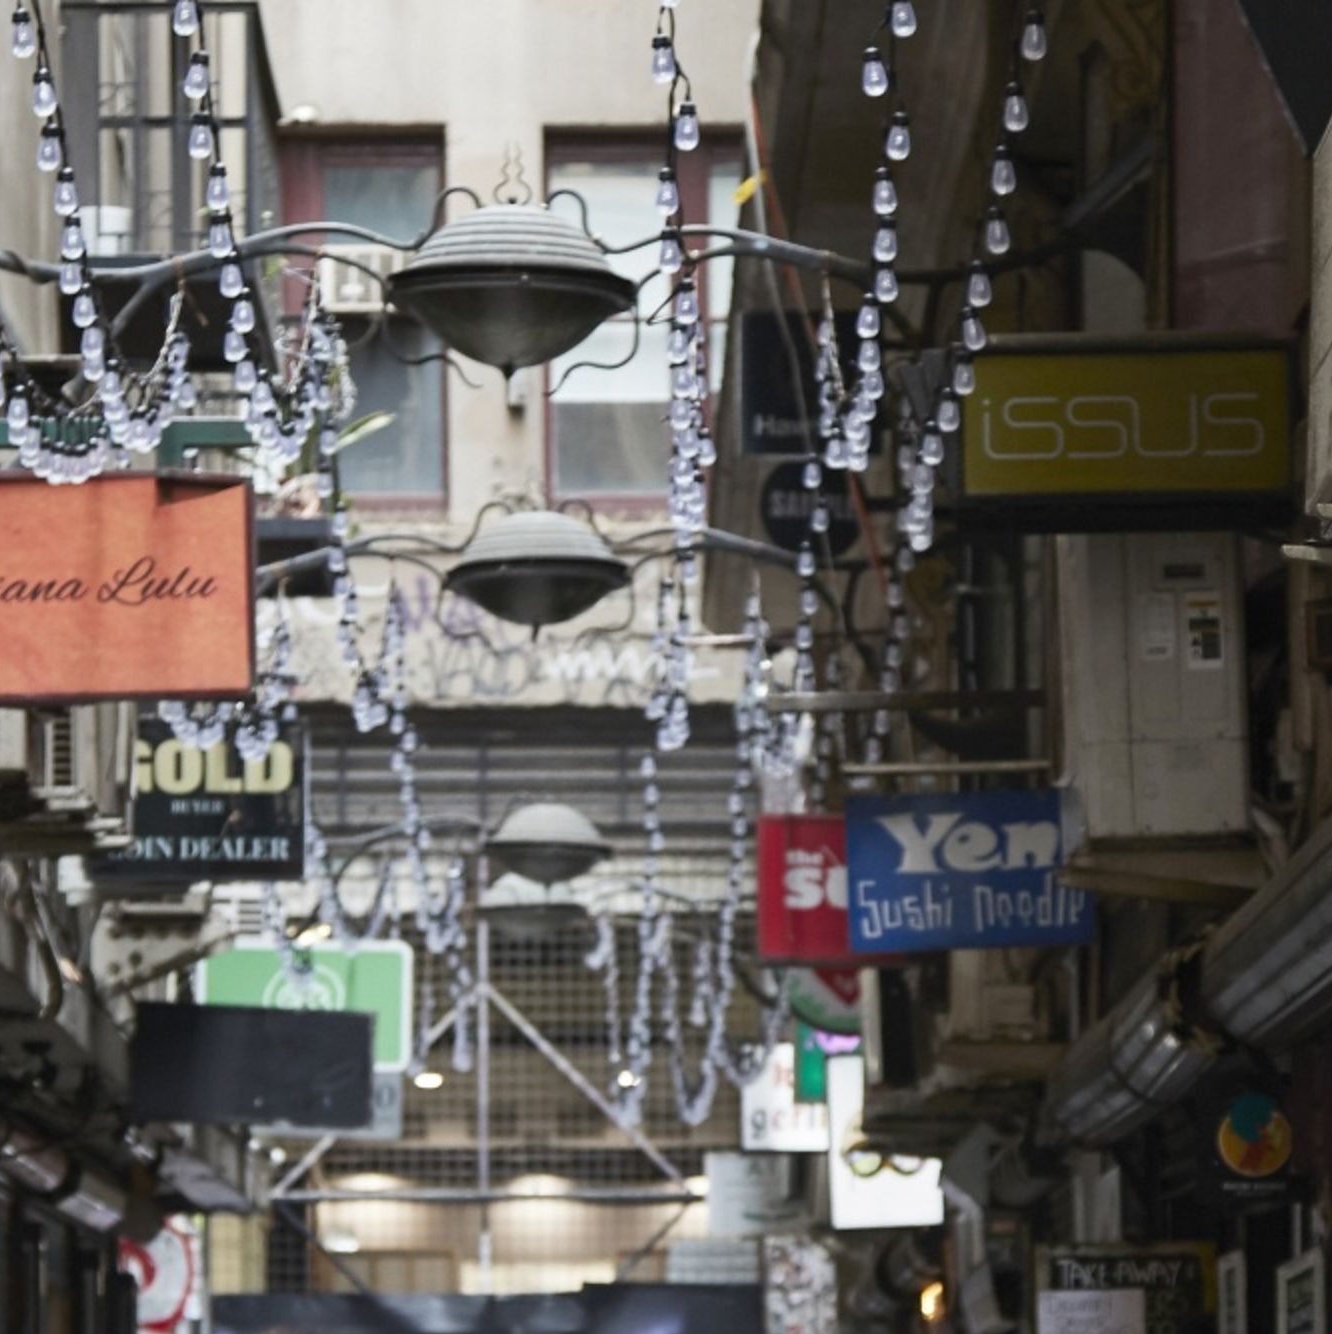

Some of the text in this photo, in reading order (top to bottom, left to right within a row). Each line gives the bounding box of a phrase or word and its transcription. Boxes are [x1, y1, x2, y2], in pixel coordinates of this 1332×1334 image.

[95, 556, 220, 606] Lulu
[125, 837, 290, 861] OIN DEALER
[875, 811, 1060, 875] Yen
[856, 879, 953, 941] Sushi
